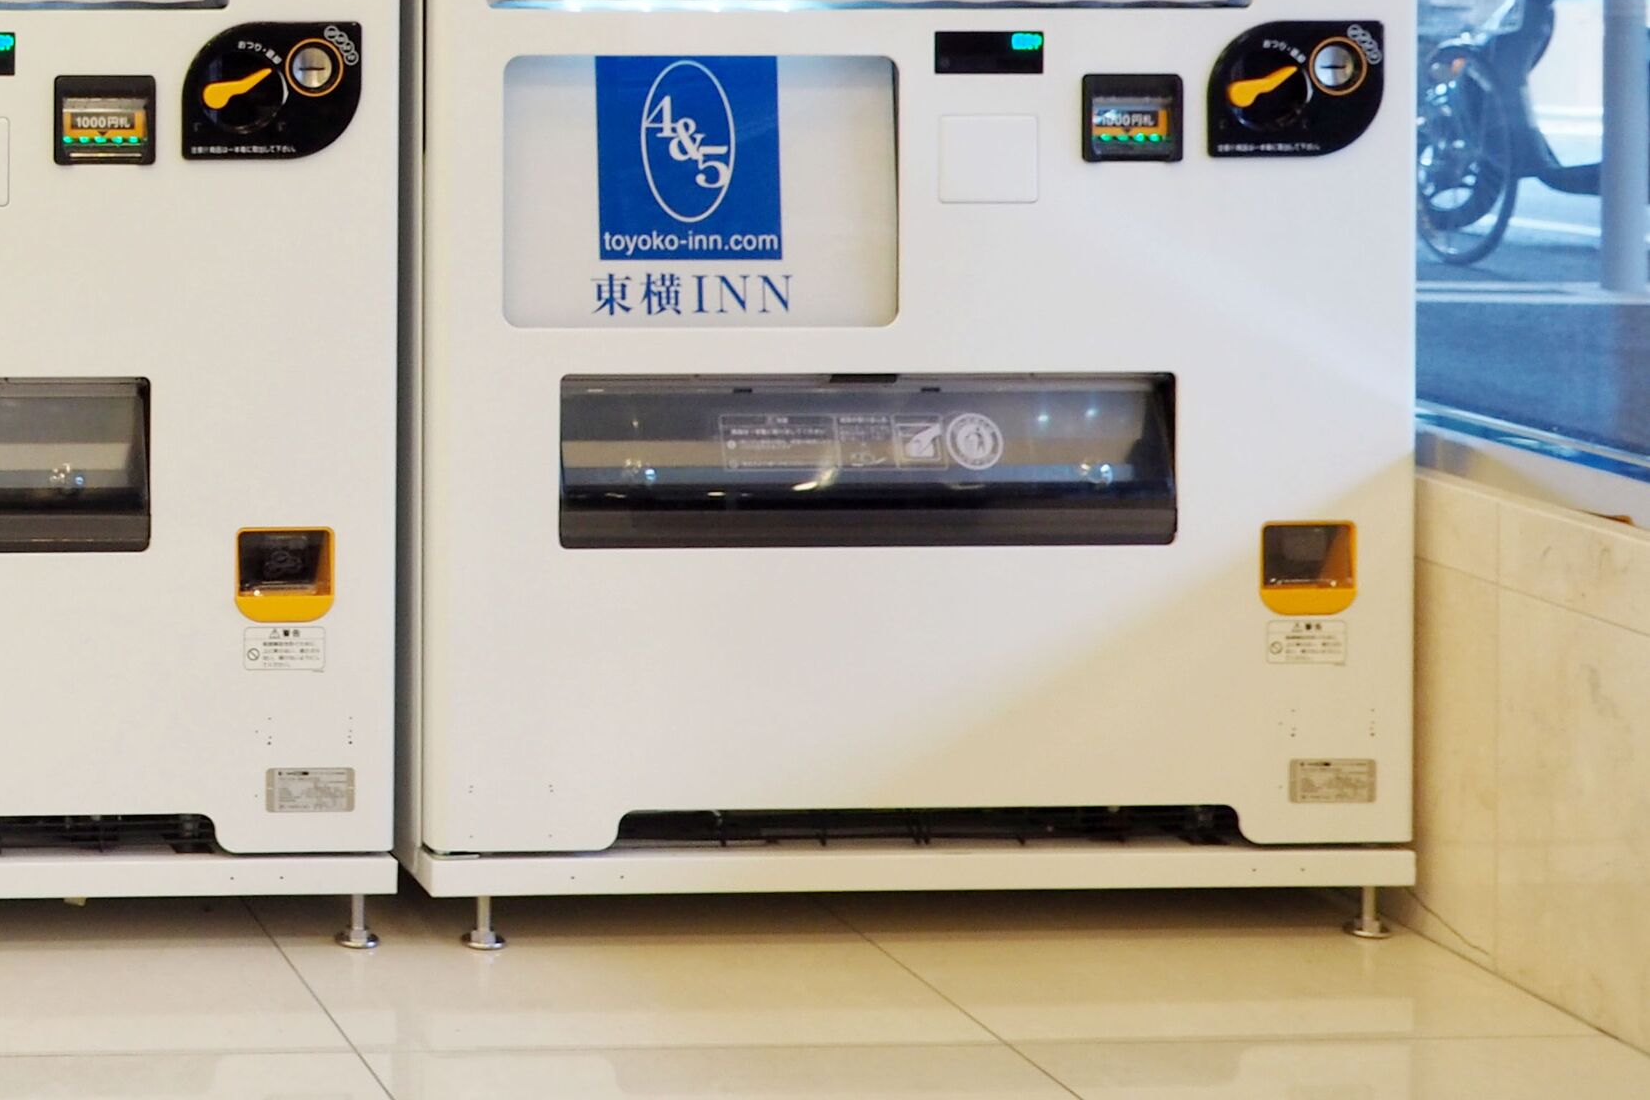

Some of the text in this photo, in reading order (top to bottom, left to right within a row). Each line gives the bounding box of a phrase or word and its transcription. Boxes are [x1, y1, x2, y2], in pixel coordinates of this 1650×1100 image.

[76, 115, 132, 129] 1000円札
[644, 94, 730, 188] 4&5
[604, 230, 779, 255] toyoko-inn.com
[590, 273, 793, 317] 東横INN
